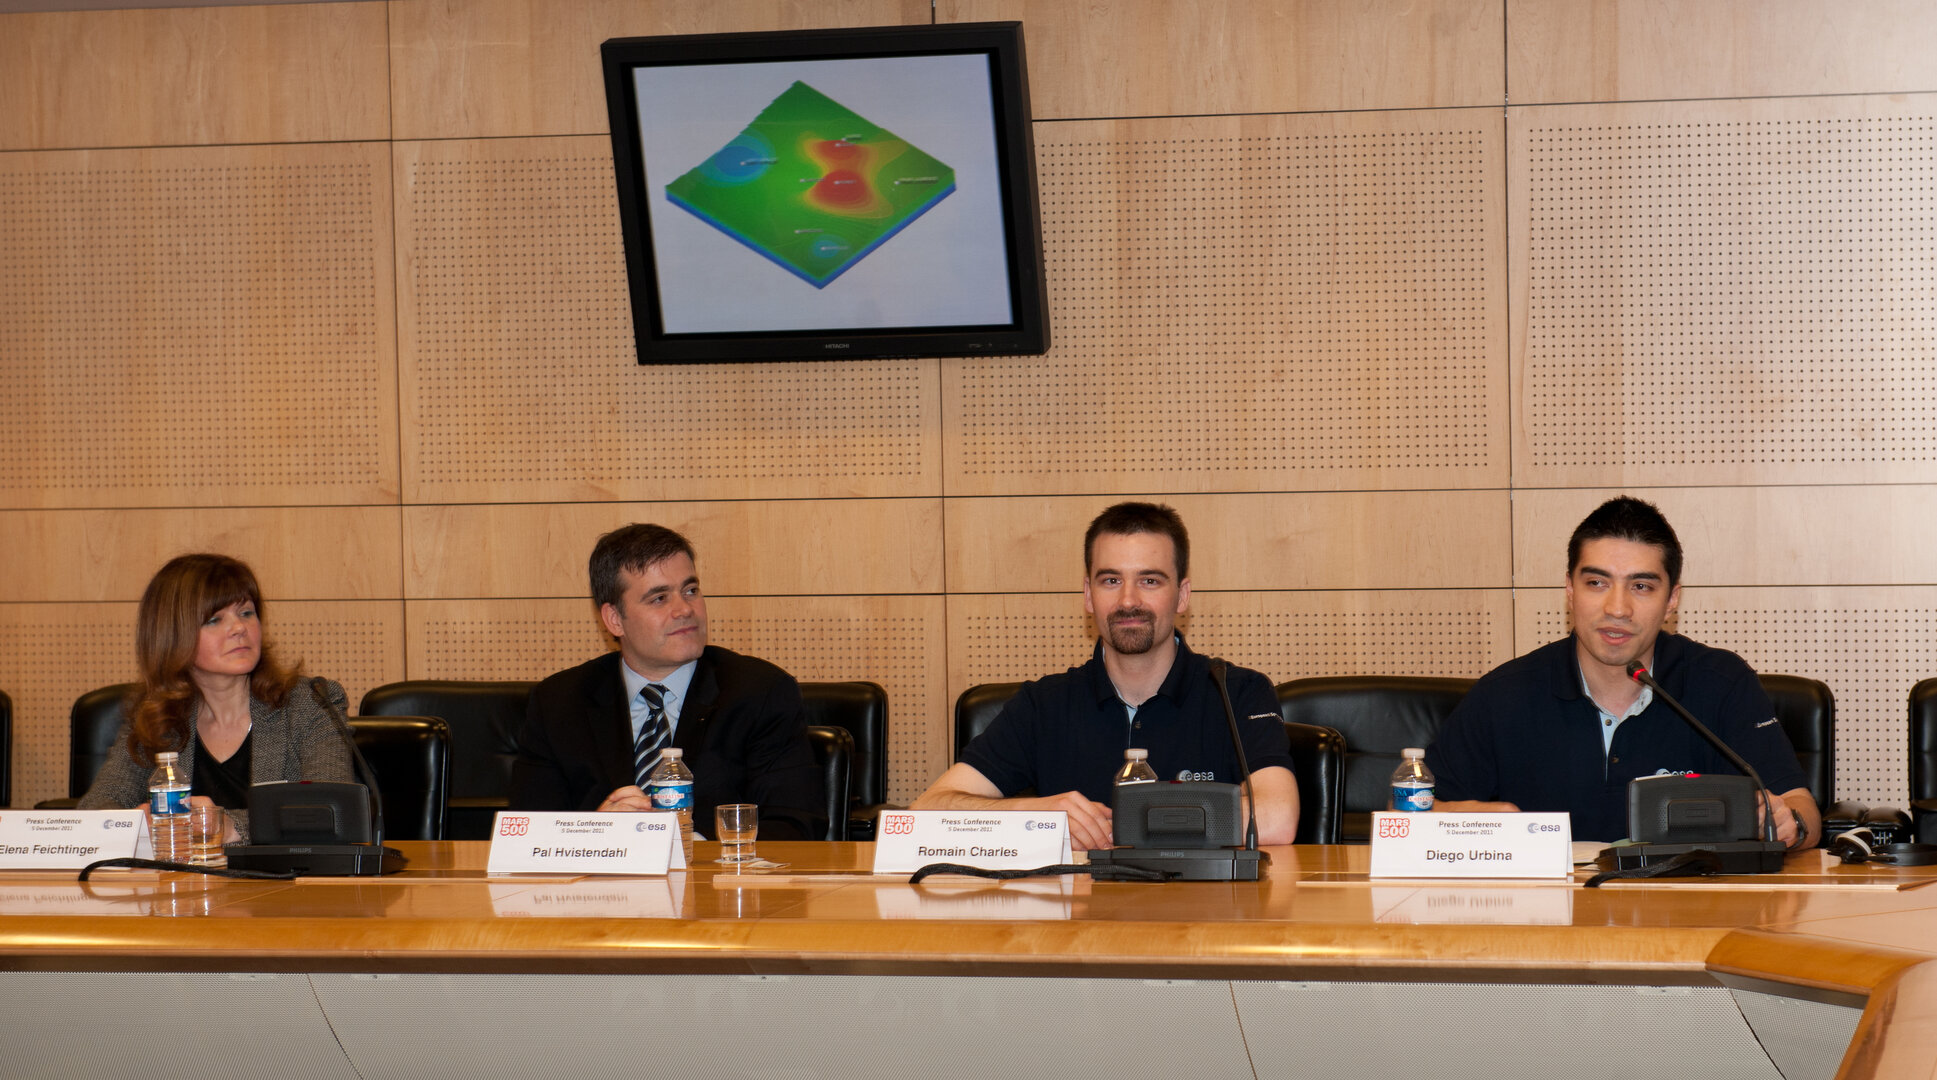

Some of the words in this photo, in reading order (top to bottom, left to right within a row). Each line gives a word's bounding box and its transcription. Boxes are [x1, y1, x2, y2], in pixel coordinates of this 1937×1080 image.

[26, 817, 44, 825] Press
[46, 817, 82, 825] Conference
[114, 819, 133, 828] esa
[502, 816, 530, 825] MARS
[556, 819, 574, 827] Press
[576, 819, 613, 827] Conference
[886, 815, 915, 824] MARS
[963, 818, 1002, 826] Conference
[1379, 817, 1410, 826] MARS
[1438, 820, 1459, 828] Press
[1462, 820, 1502, 828] Conference
[500, 824, 529, 836] 500
[647, 823, 667, 831] esa
[884, 823, 914, 835] 500
[1037, 822, 1057, 830] esa
[1540, 824, 1561, 832] esa
[1379, 825, 1410, 838] 500
[0, 844, 29, 855] Elena
[33, 844, 100, 857] Feichtinger
[532, 847, 551, 858] Pal
[555, 847, 627, 858] Hvistendahl
[918, 846, 966, 857] Romain
[970, 846, 1018, 857] Charles
[1426, 850, 1464, 863] Diego
[1469, 850, 1512, 861] Urbina
